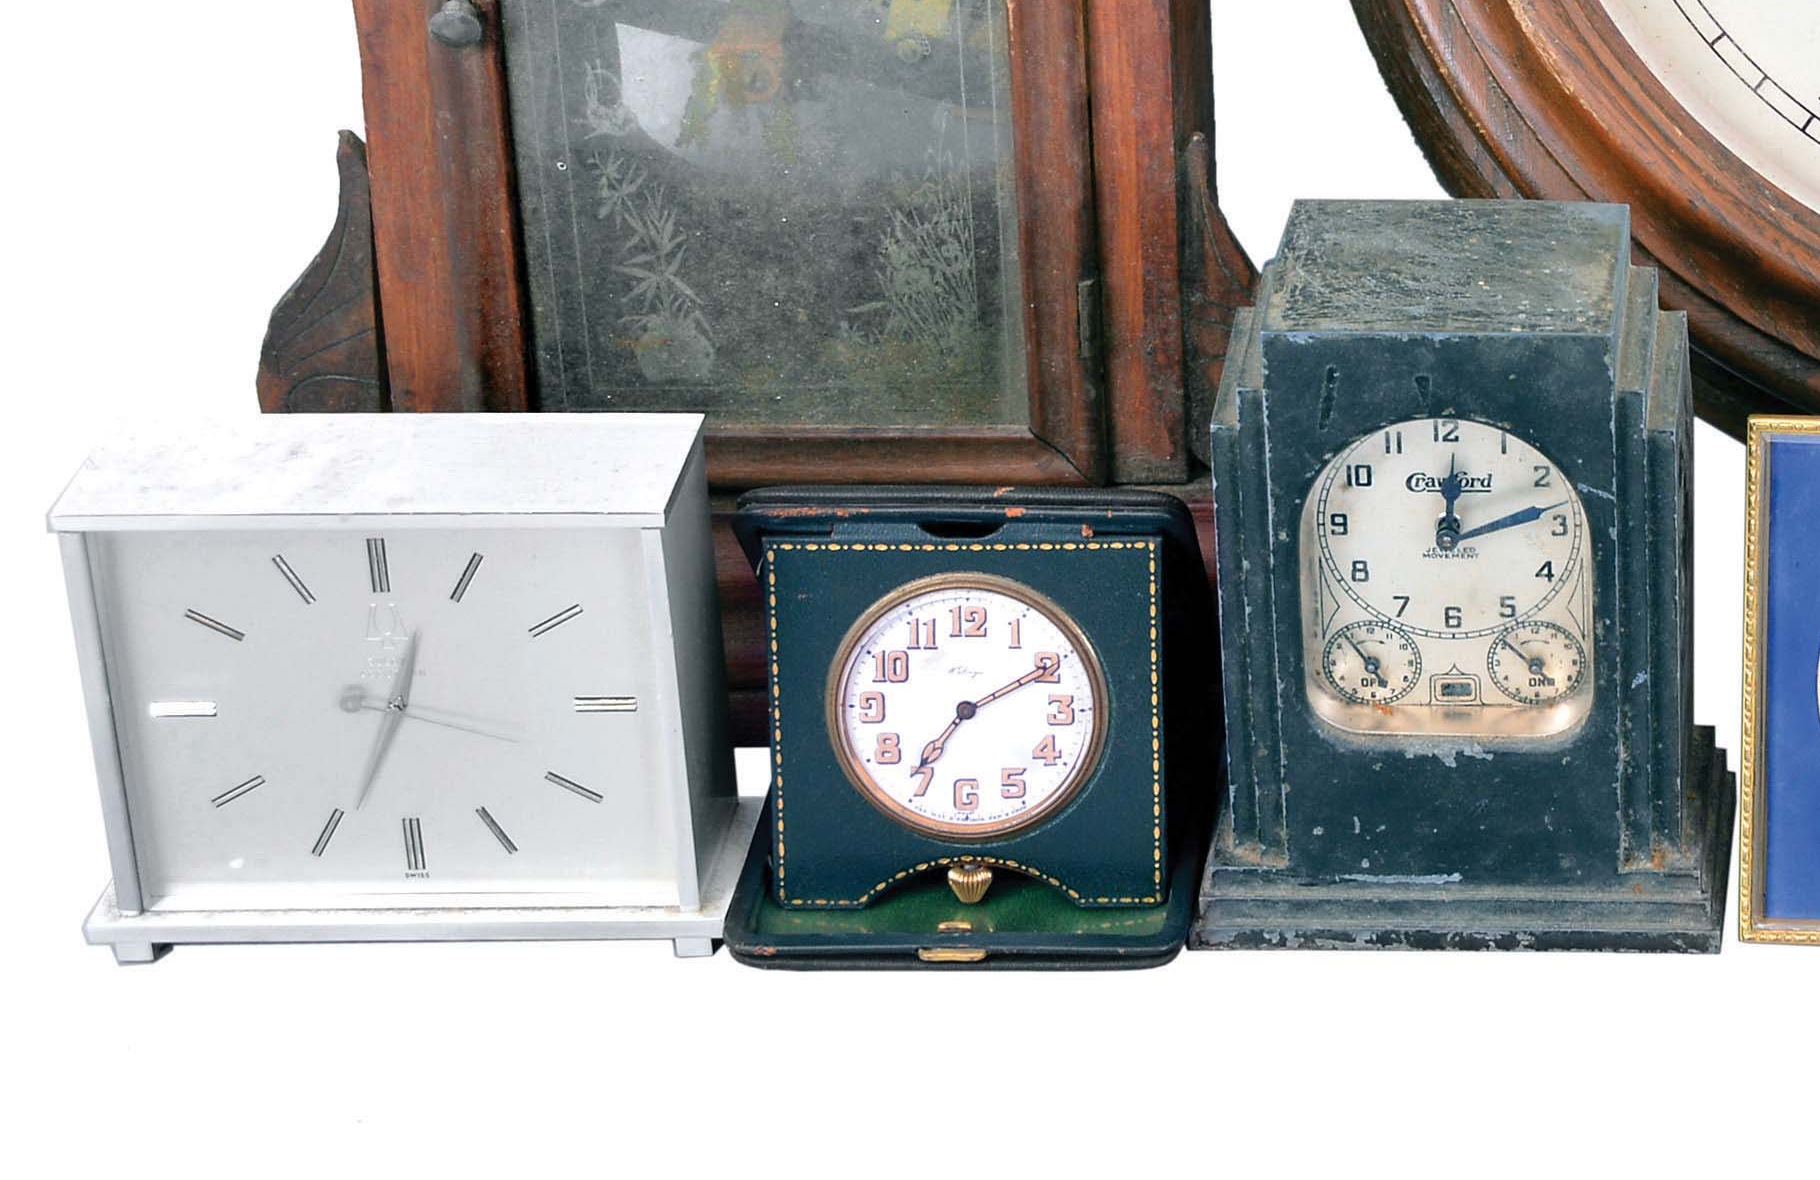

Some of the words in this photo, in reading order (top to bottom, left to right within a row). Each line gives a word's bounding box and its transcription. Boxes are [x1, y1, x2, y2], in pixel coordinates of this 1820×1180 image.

[1384, 431, 1403, 454] 11
[1432, 420, 1460, 443] 12
[1346, 464, 1373, 487] 10
[1533, 465, 1551, 488] 2
[1330, 513, 1348, 536] 9
[1551, 514, 1569, 537] 3
[1351, 560, 1369, 582] 8
[1535, 561, 1555, 583] 4
[1392, 596, 1410, 618] 7
[1444, 606, 1463, 629] 6
[1499, 596, 1517, 618] 5
[906, 618, 938, 650] 11
[949, 605, 987, 637] 12
[1008, 618, 1022, 649] 1
[872, 650, 909, 683] 10
[1034, 651, 1061, 684] 2
[858, 691, 886, 724] 9
[1047, 694, 1074, 725] 3
[874, 732, 901, 765] 8
[1032, 734, 1062, 766] 4
[910, 766, 935, 797] 7
[1000, 768, 1027, 799] 5
